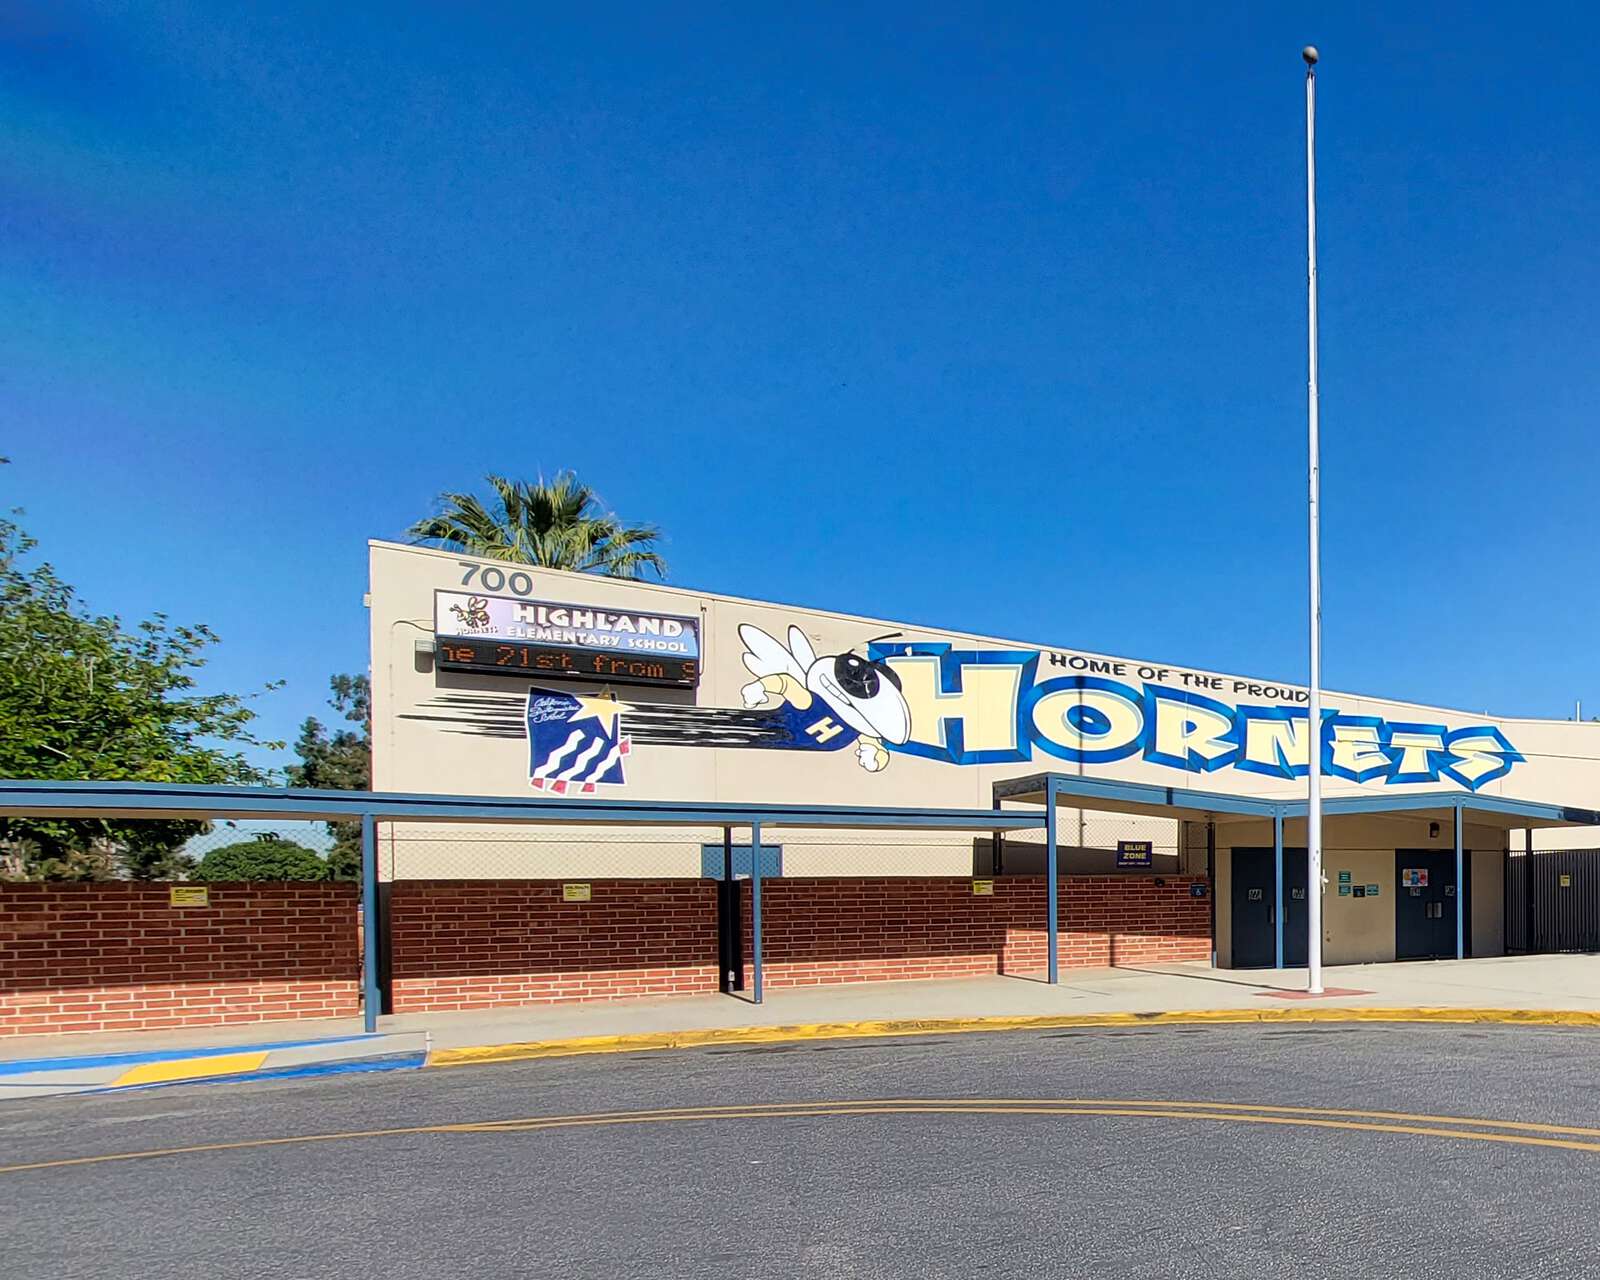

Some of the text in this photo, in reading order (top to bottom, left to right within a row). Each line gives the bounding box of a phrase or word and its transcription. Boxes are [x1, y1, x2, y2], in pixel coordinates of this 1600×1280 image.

[458, 562, 533, 596] 700
[512, 604, 683, 637] HIGHLAND
[507, 626, 688, 653] ELEMENTARY SCHOOL
[593, 654, 664, 677] from
[1048, 651, 1311, 703] HOME OF THE PROUD
[804, 717, 844, 744] H
[868, 642, 1528, 793] HORNETS
